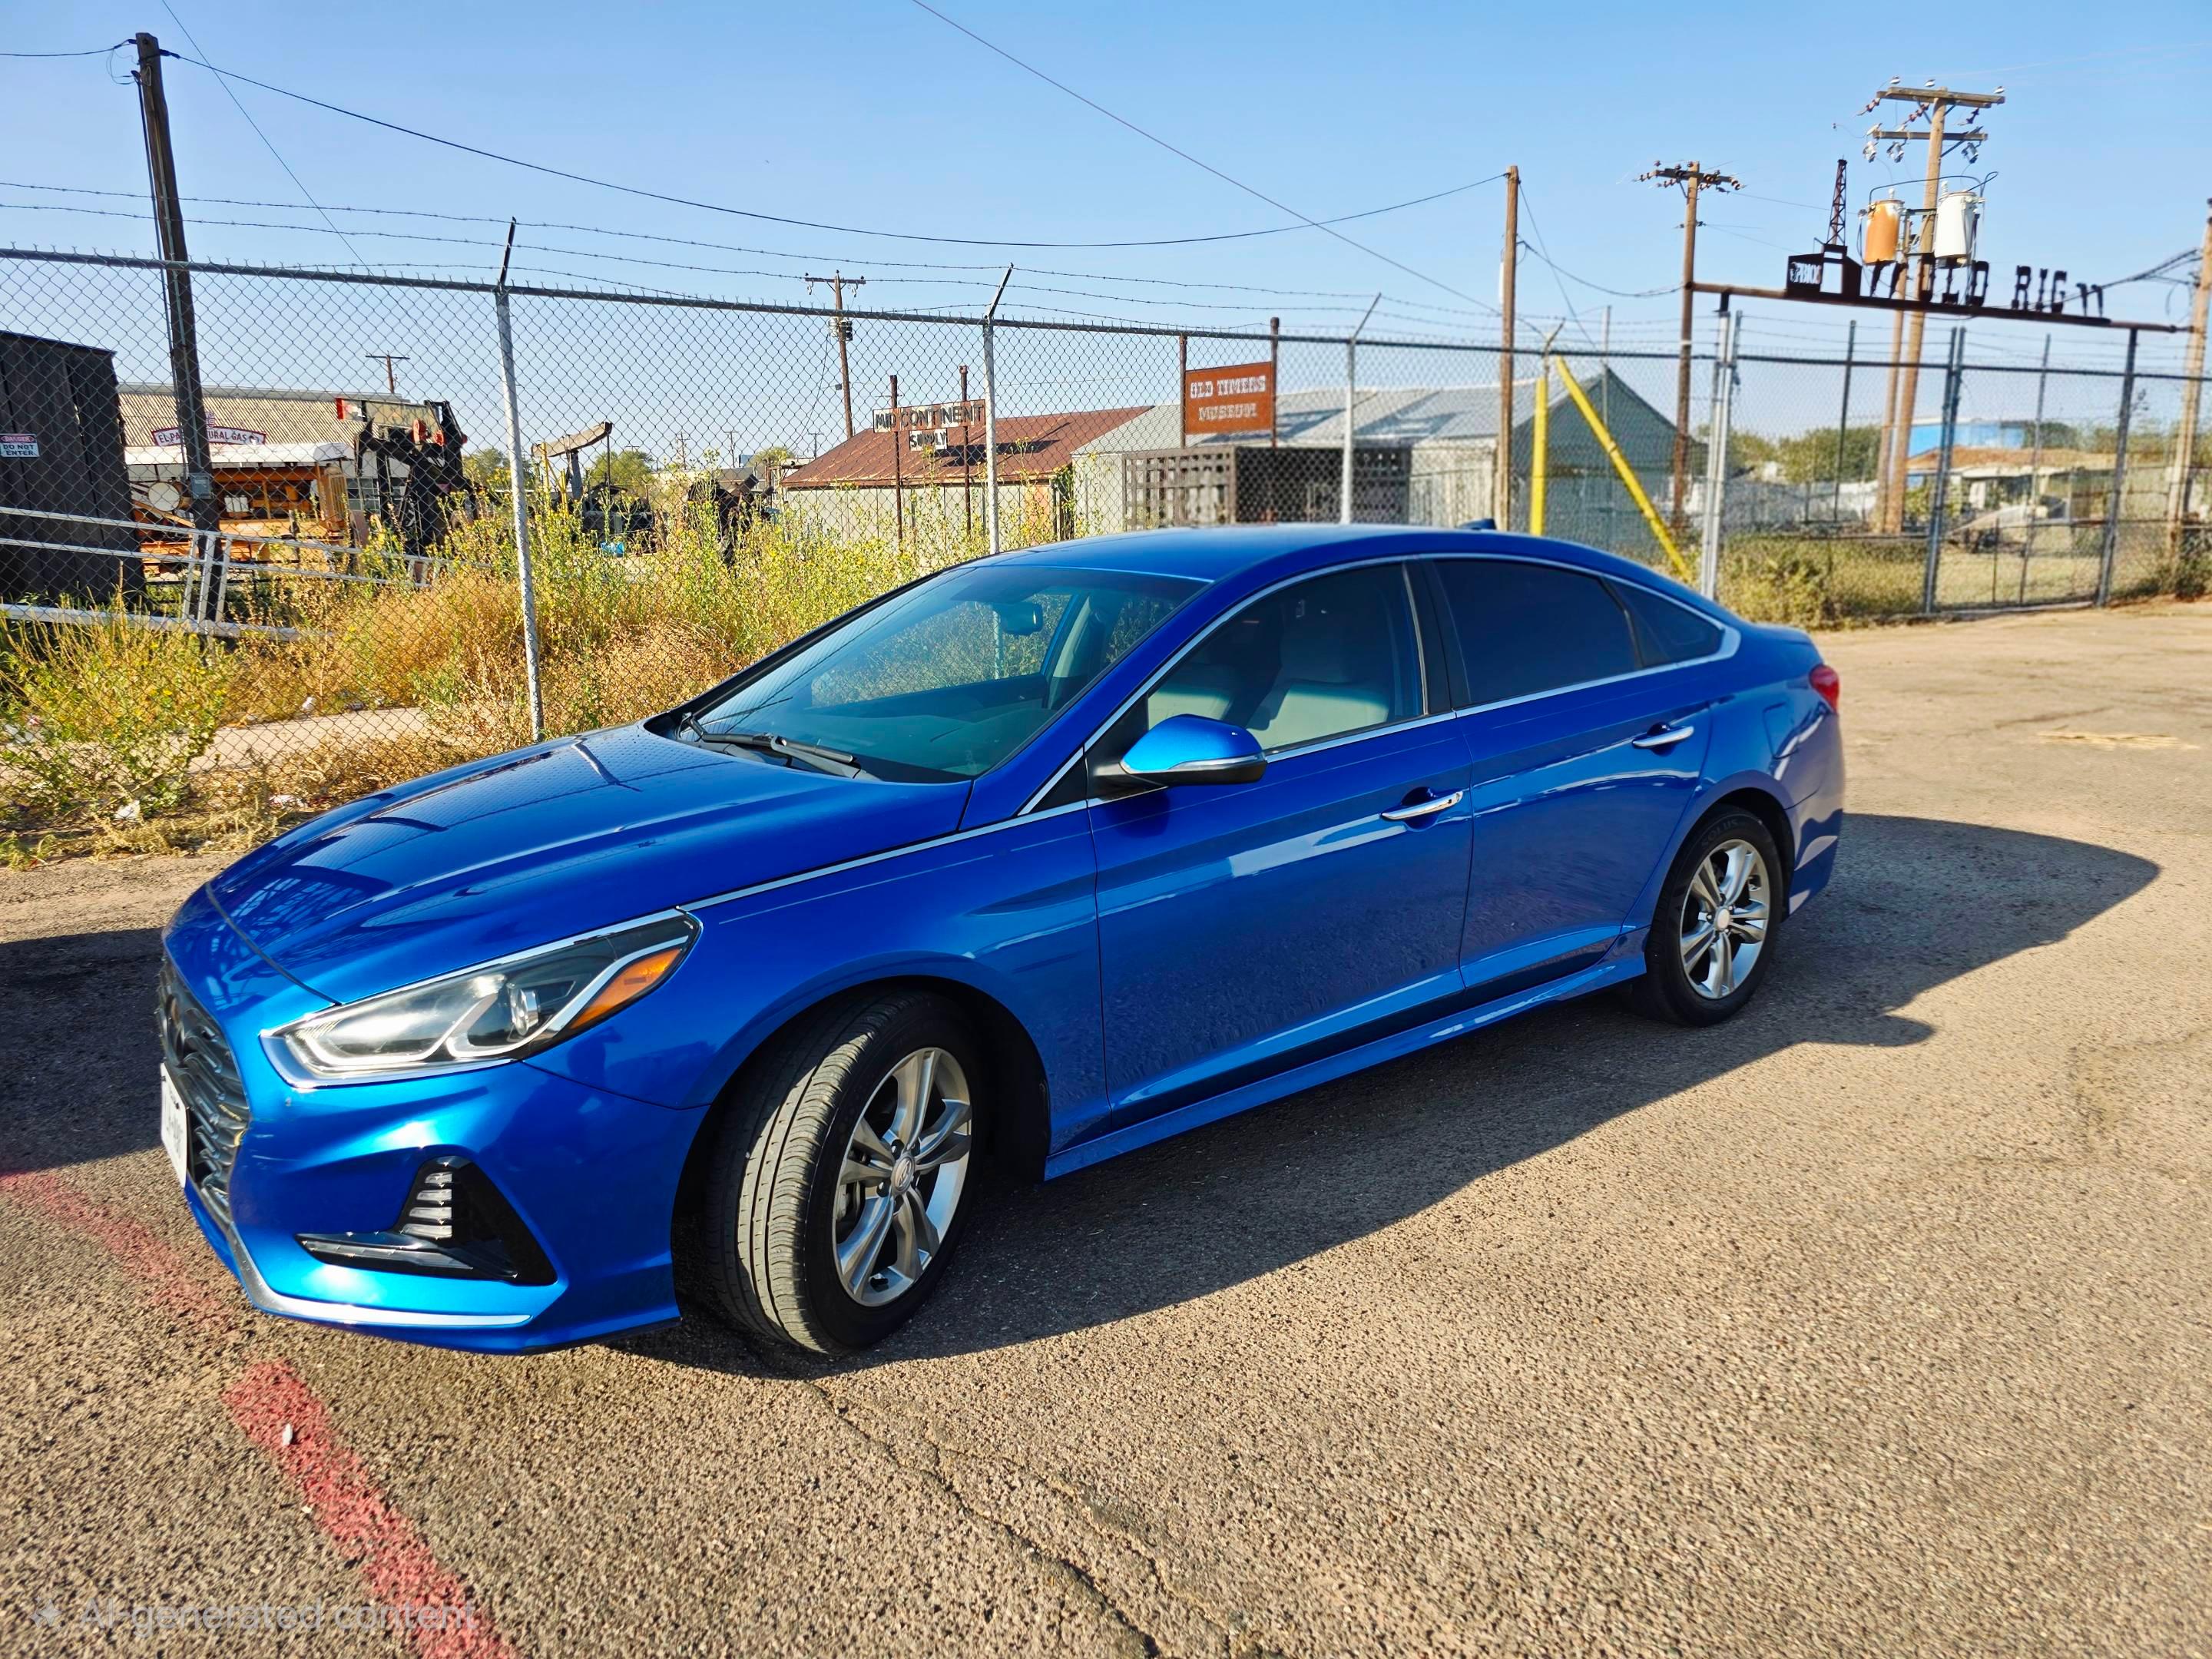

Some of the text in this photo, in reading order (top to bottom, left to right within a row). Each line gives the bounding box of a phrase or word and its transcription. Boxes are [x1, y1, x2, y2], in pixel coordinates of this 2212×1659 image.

[1190, 375, 1267, 399] OLD TIMERS
[875, 412, 897, 429] MID
[1198, 402, 1257, 422] MUSEUM
[158, 434, 169, 443] EL
[171, 432, 182, 442] PA
[207, 429, 230, 440] URAL
[231, 432, 247, 442] GAS
